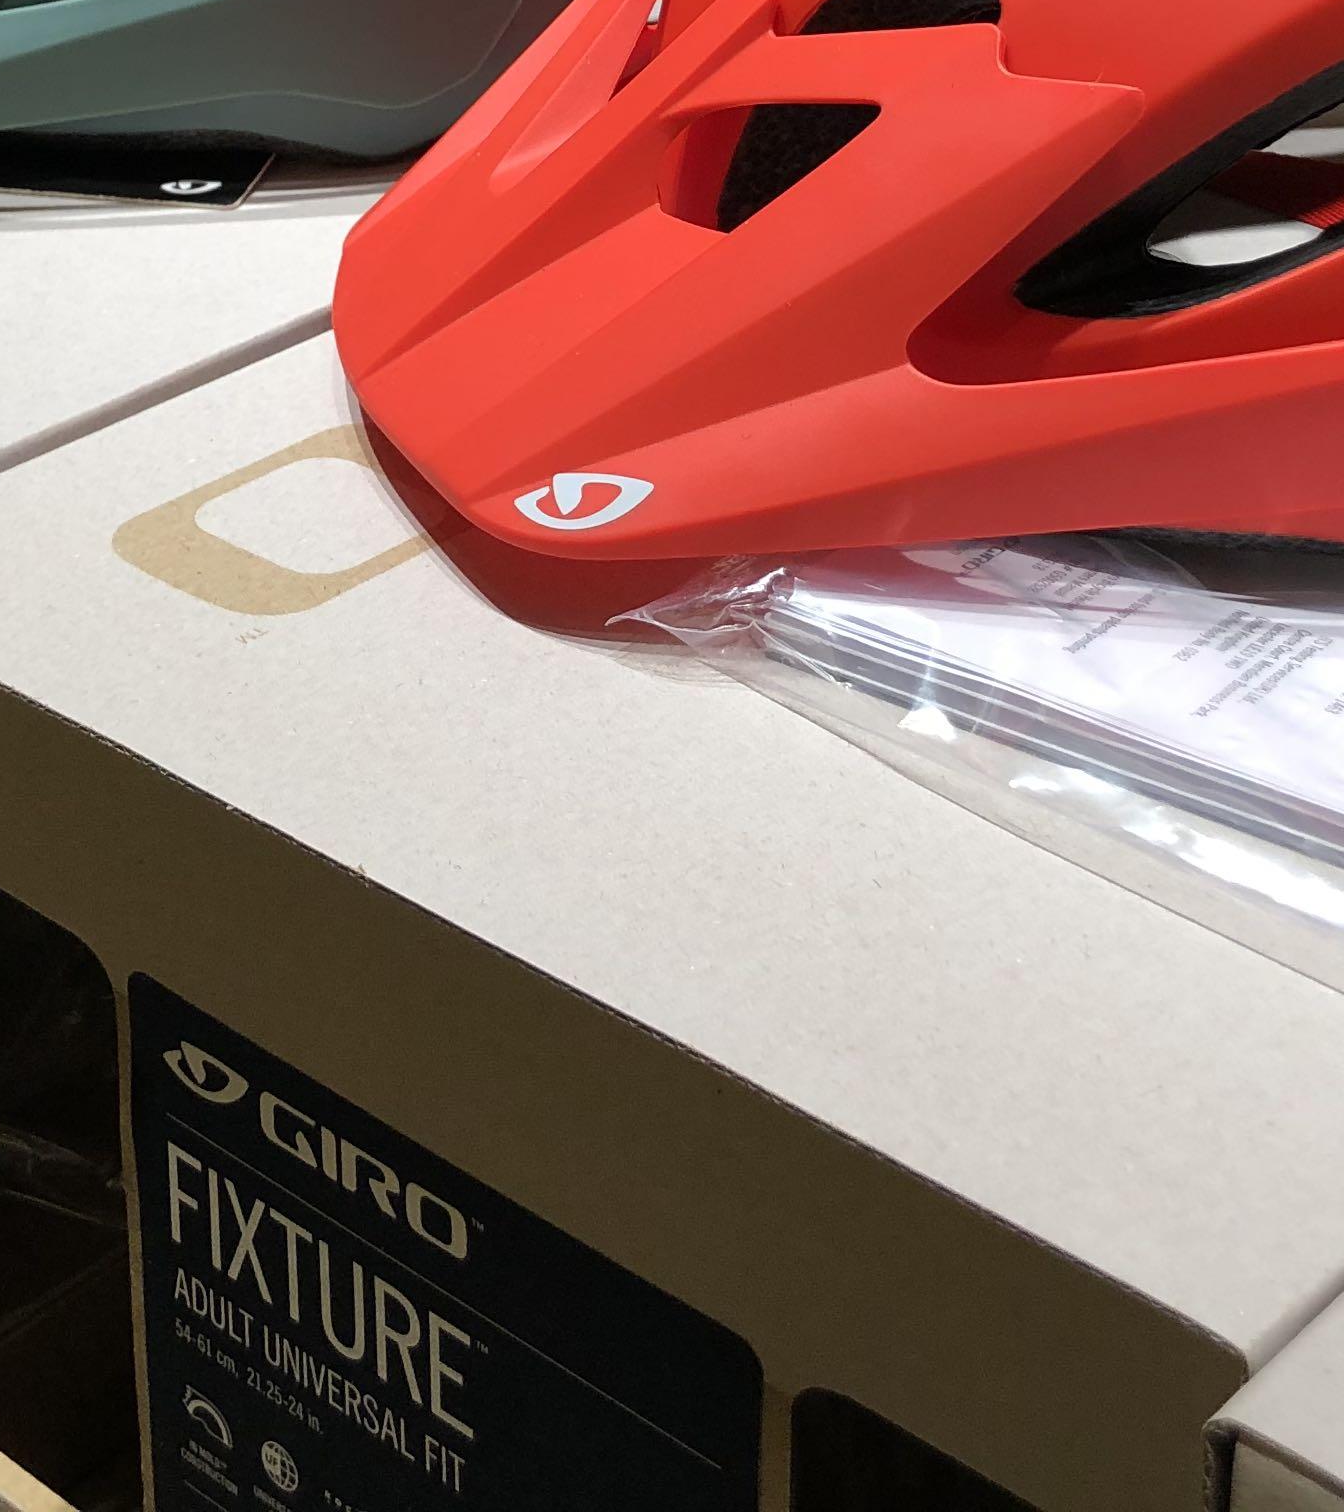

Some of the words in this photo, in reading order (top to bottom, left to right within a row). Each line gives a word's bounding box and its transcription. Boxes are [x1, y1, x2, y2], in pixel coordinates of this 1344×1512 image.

[259, 1090, 469, 1260] GIRO
[166, 1139, 474, 1441] FIXTURE
[174, 1267, 254, 1349] ADULT
[263, 1324, 416, 1463] UNIVERSAL
[424, 1433, 466, 1493] FIT
